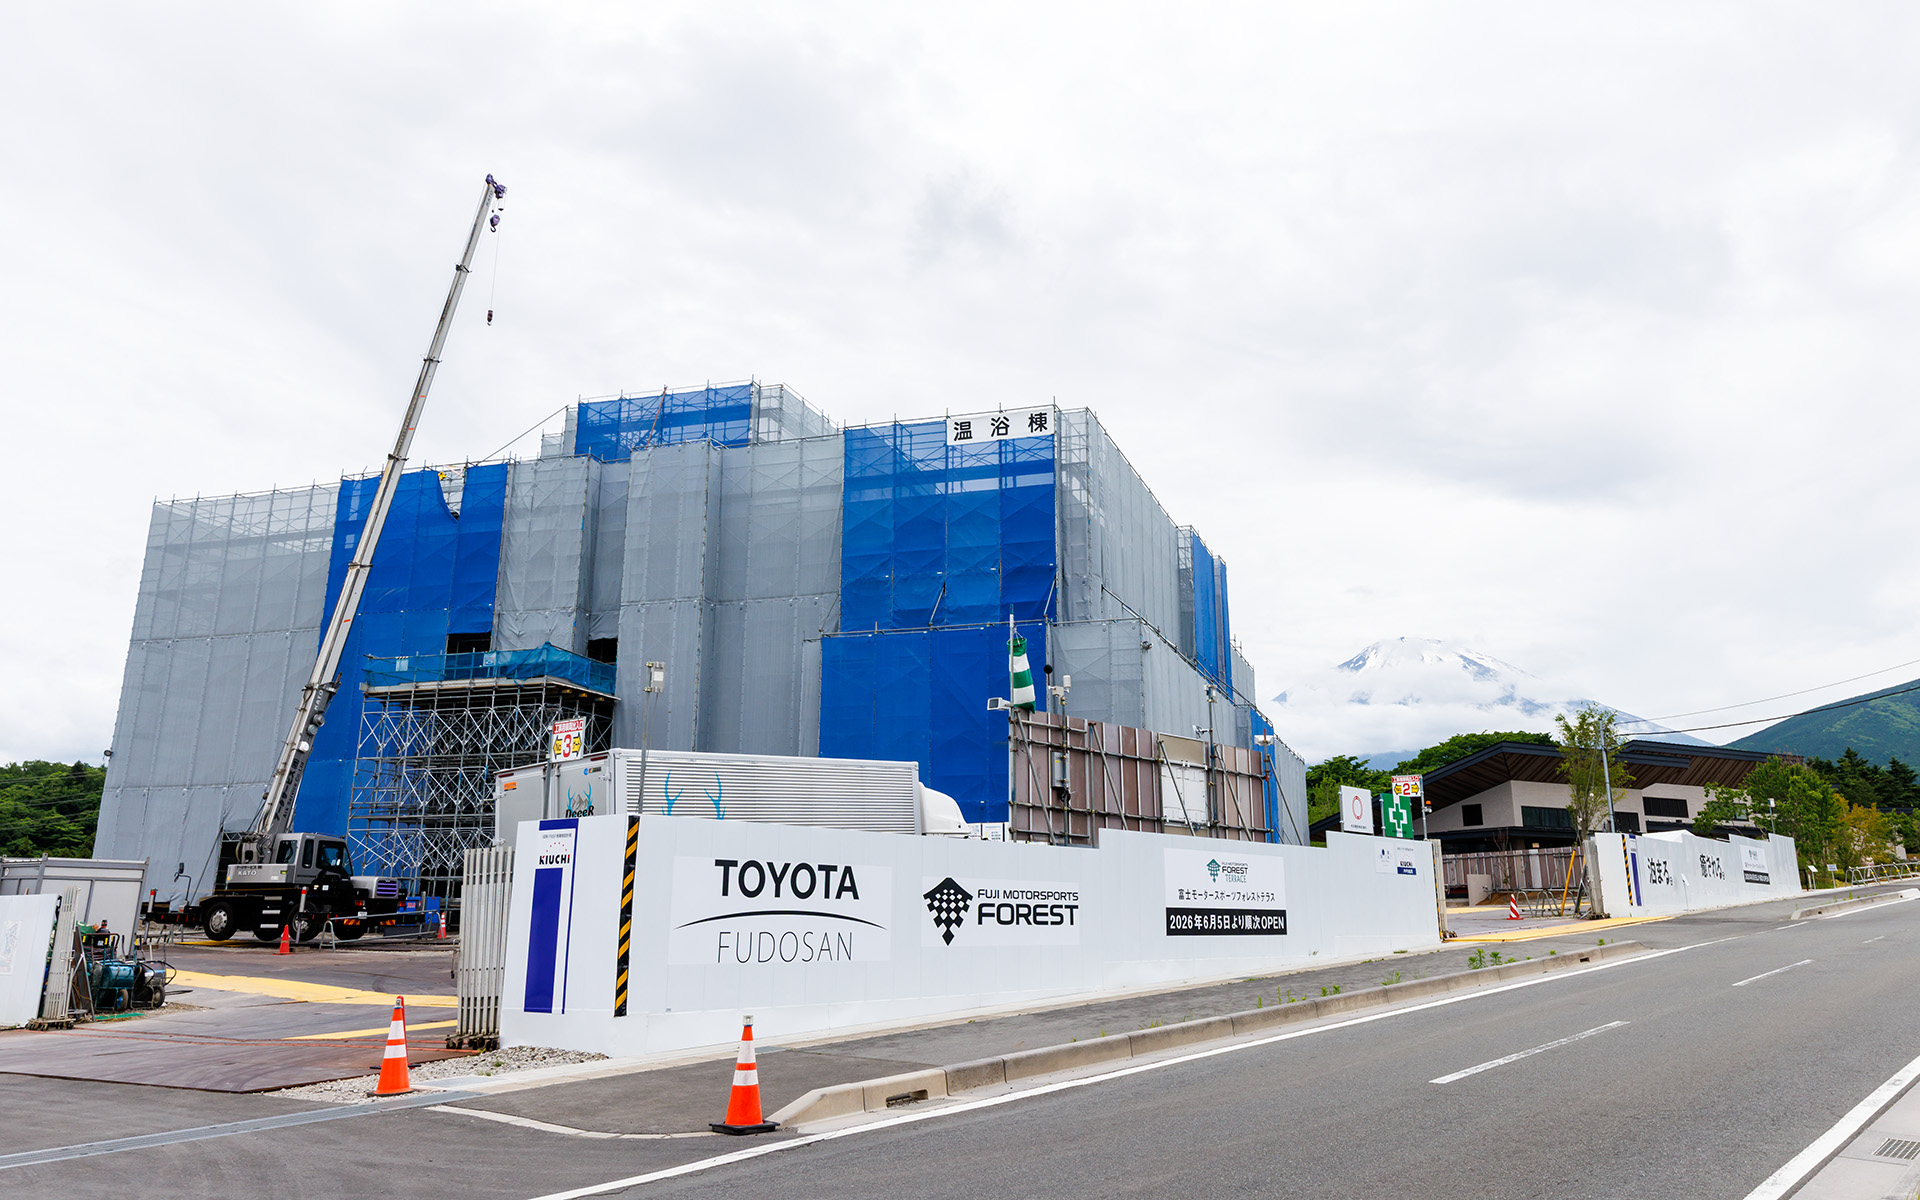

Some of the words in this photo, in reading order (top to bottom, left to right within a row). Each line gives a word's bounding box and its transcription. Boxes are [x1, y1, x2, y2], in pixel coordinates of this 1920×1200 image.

[953, 412, 1048, 441] 温浴棟
[314, 690, 324, 711] KATO
[562, 734, 572, 758] 3
[1403, 783, 1411, 795] 2
[539, 854, 571, 865] KIUCHI
[1221, 866, 1248, 874] FOREST
[1225, 874, 1247, 883] TERRACE
[714, 858, 860, 900] TOYOTA
[977, 888, 1000, 899] FUJI
[1002, 889, 1079, 901] MOTORSPORTS
[1178, 888, 1276, 902] 富士モータースポーツフォレストテラス
[977, 903, 1079, 926] FOREST
[717, 931, 853, 964] FUDOSAN
